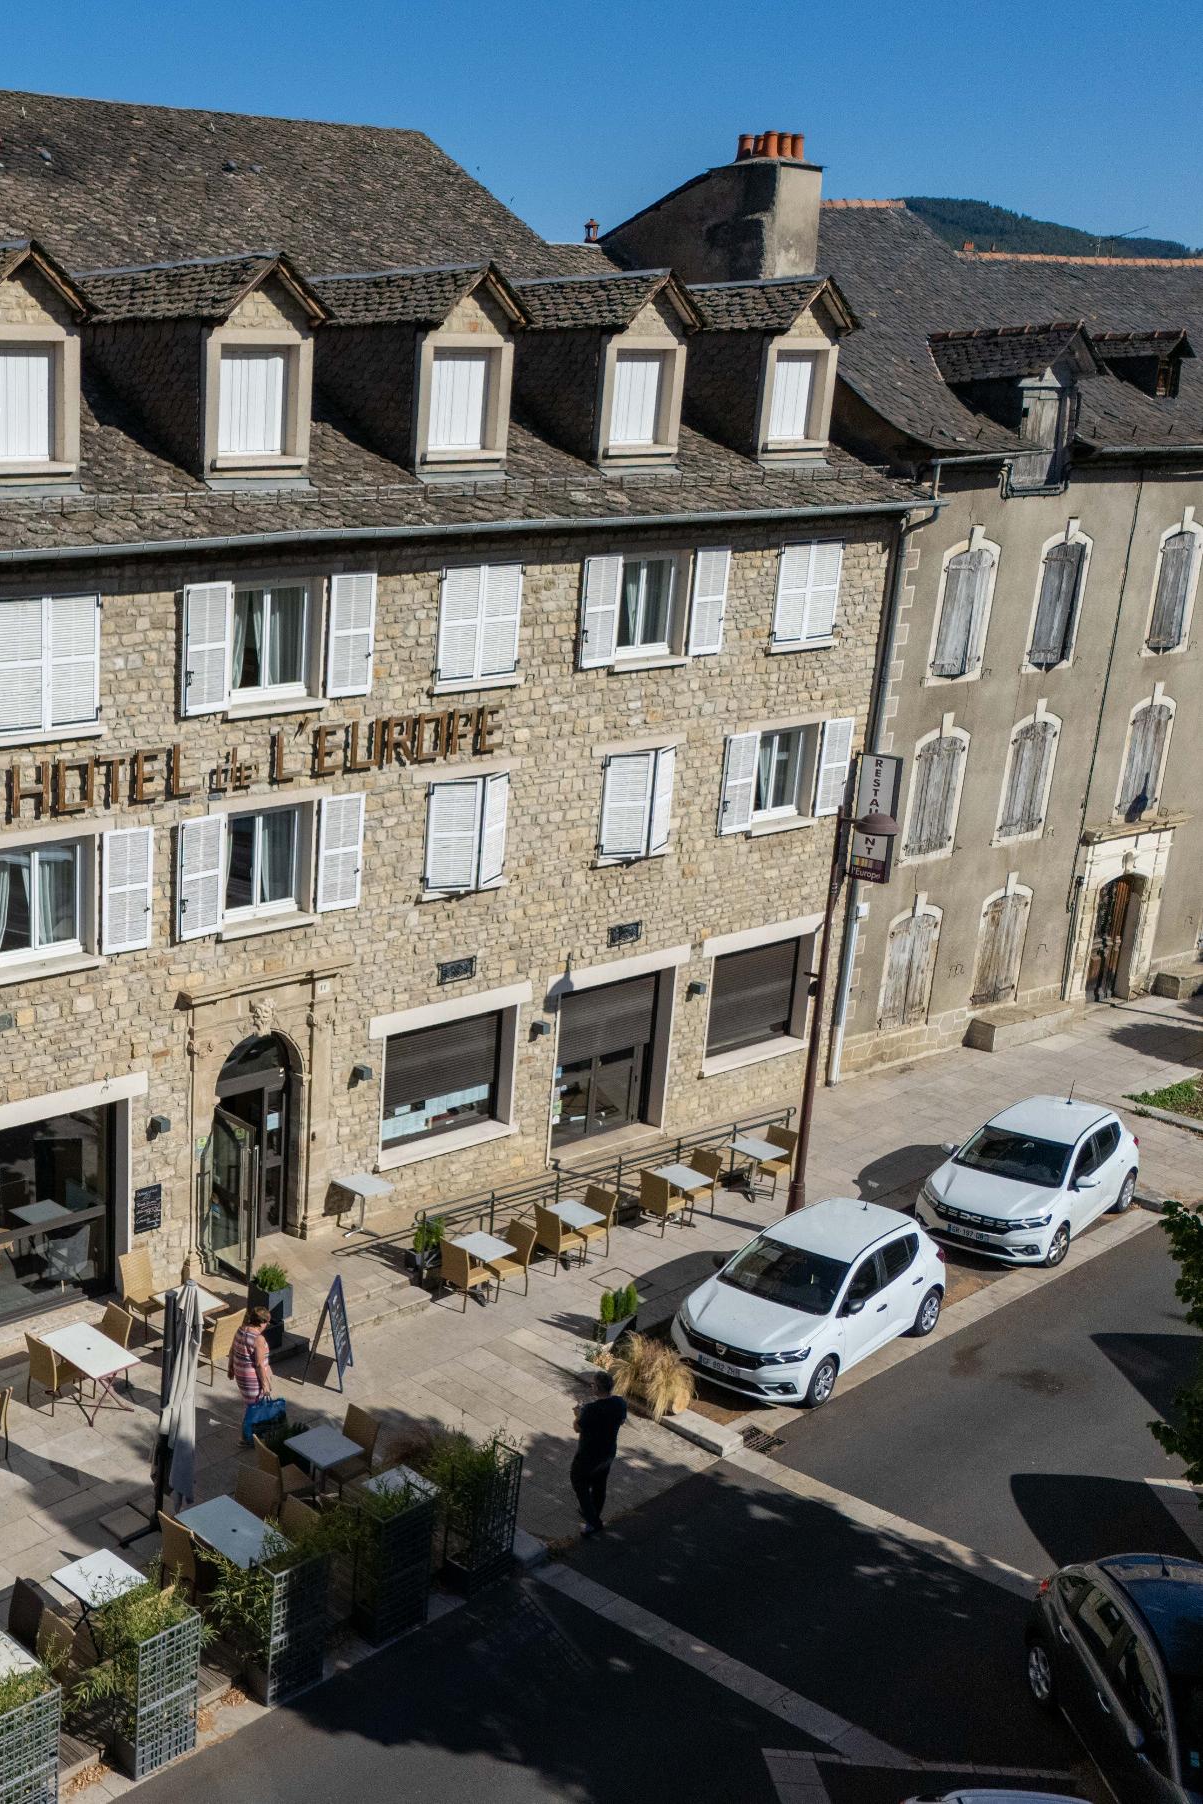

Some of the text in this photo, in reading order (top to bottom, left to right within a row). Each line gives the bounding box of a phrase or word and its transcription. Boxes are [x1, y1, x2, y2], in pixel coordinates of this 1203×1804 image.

[12, 704, 505, 818] HOTEL de L'EUROPE
[864, 758, 884, 855] RESTAUNT
